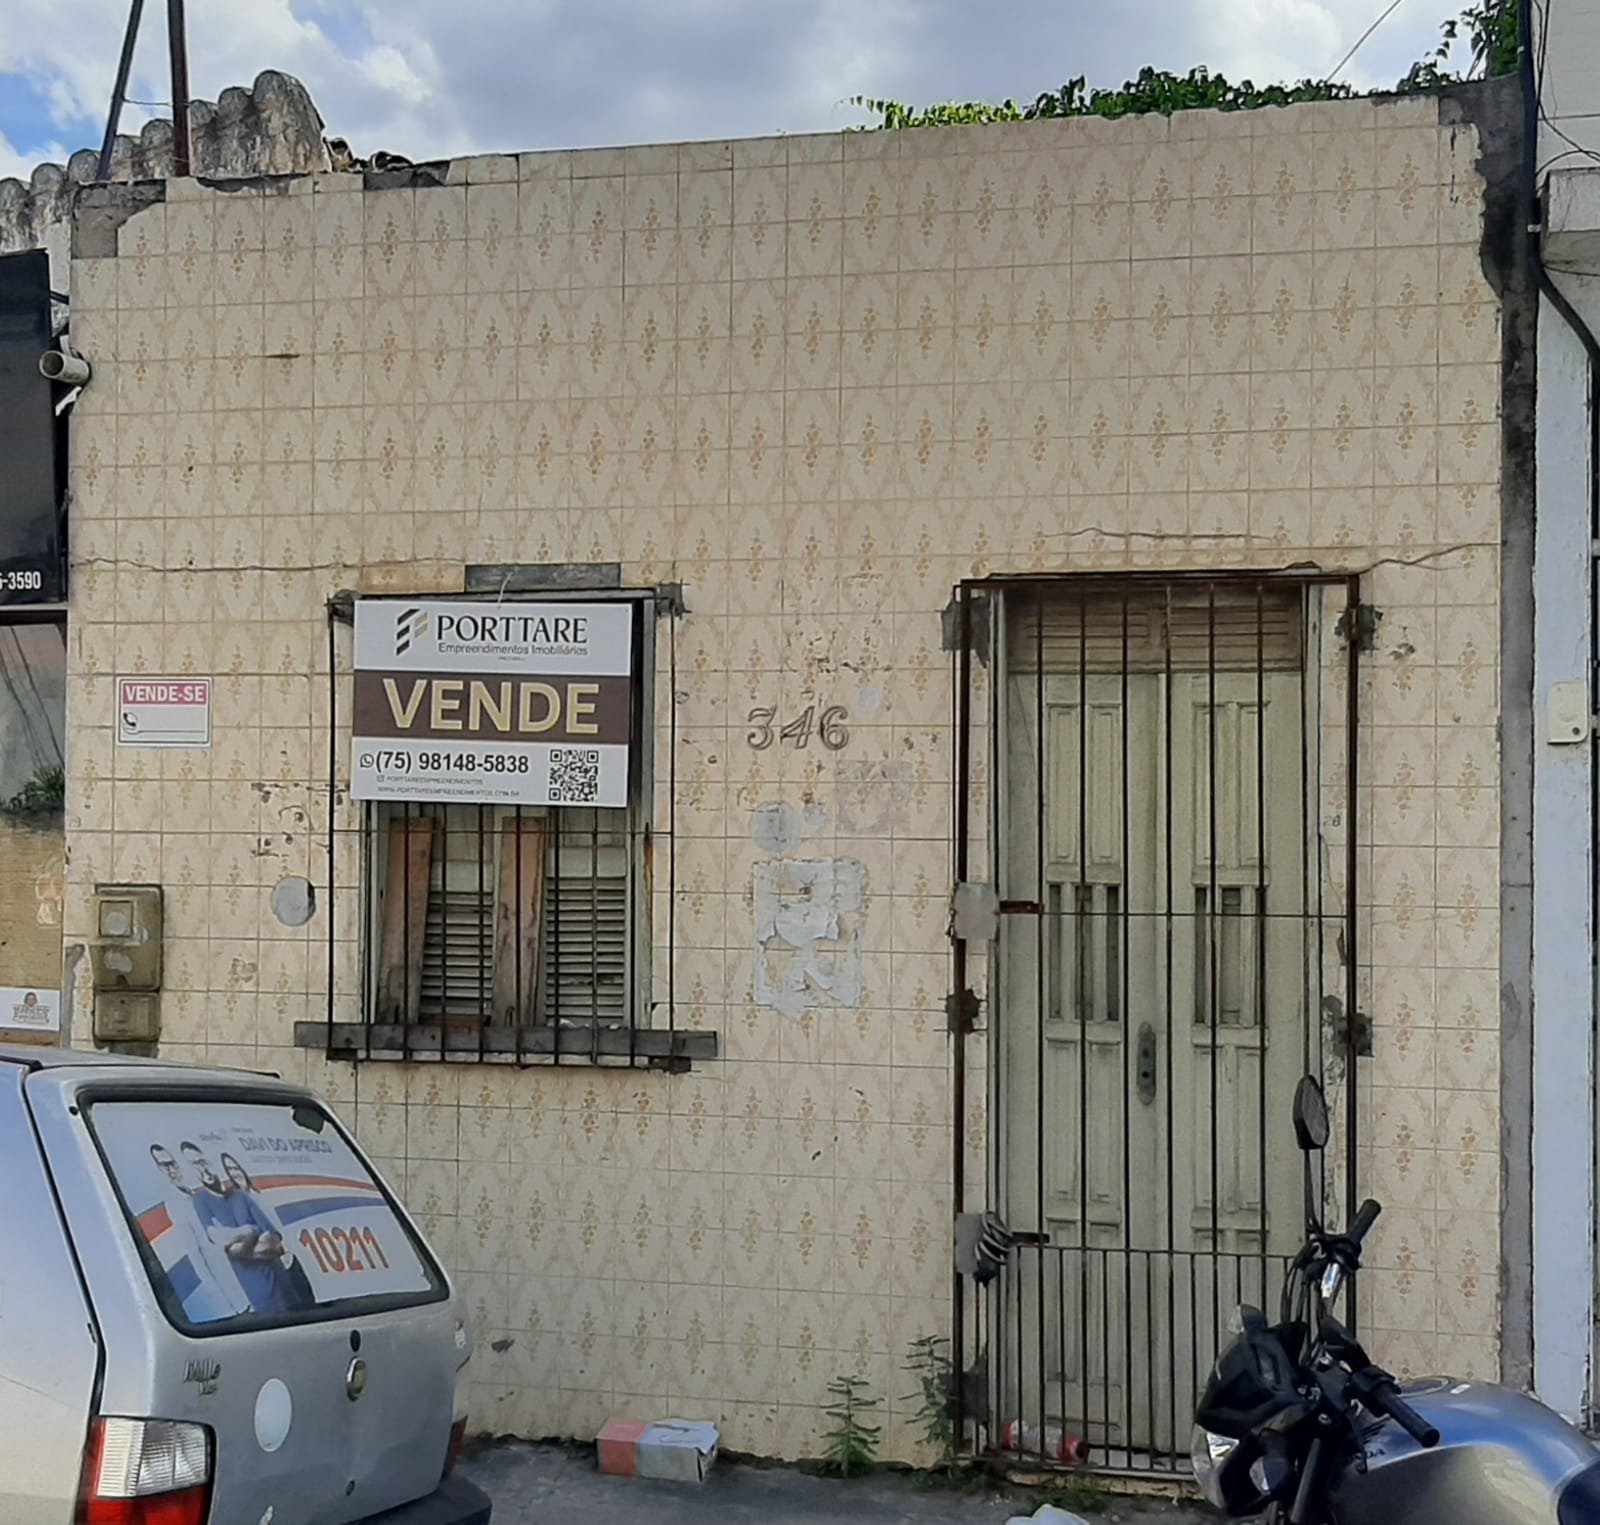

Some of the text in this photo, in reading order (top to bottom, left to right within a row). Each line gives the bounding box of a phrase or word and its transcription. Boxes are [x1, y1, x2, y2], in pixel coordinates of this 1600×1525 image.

[437, 615, 588, 644] PORTTARE
[438, 642, 529, 655] Empreendimentos
[125, 685, 205, 702] VENDE-SE
[383, 678, 599, 734] VENDE
[747, 704, 850, 751] 346
[376, 751, 529, 774] (75) 98148-5838
[299, 1226, 390, 1273] 10211
